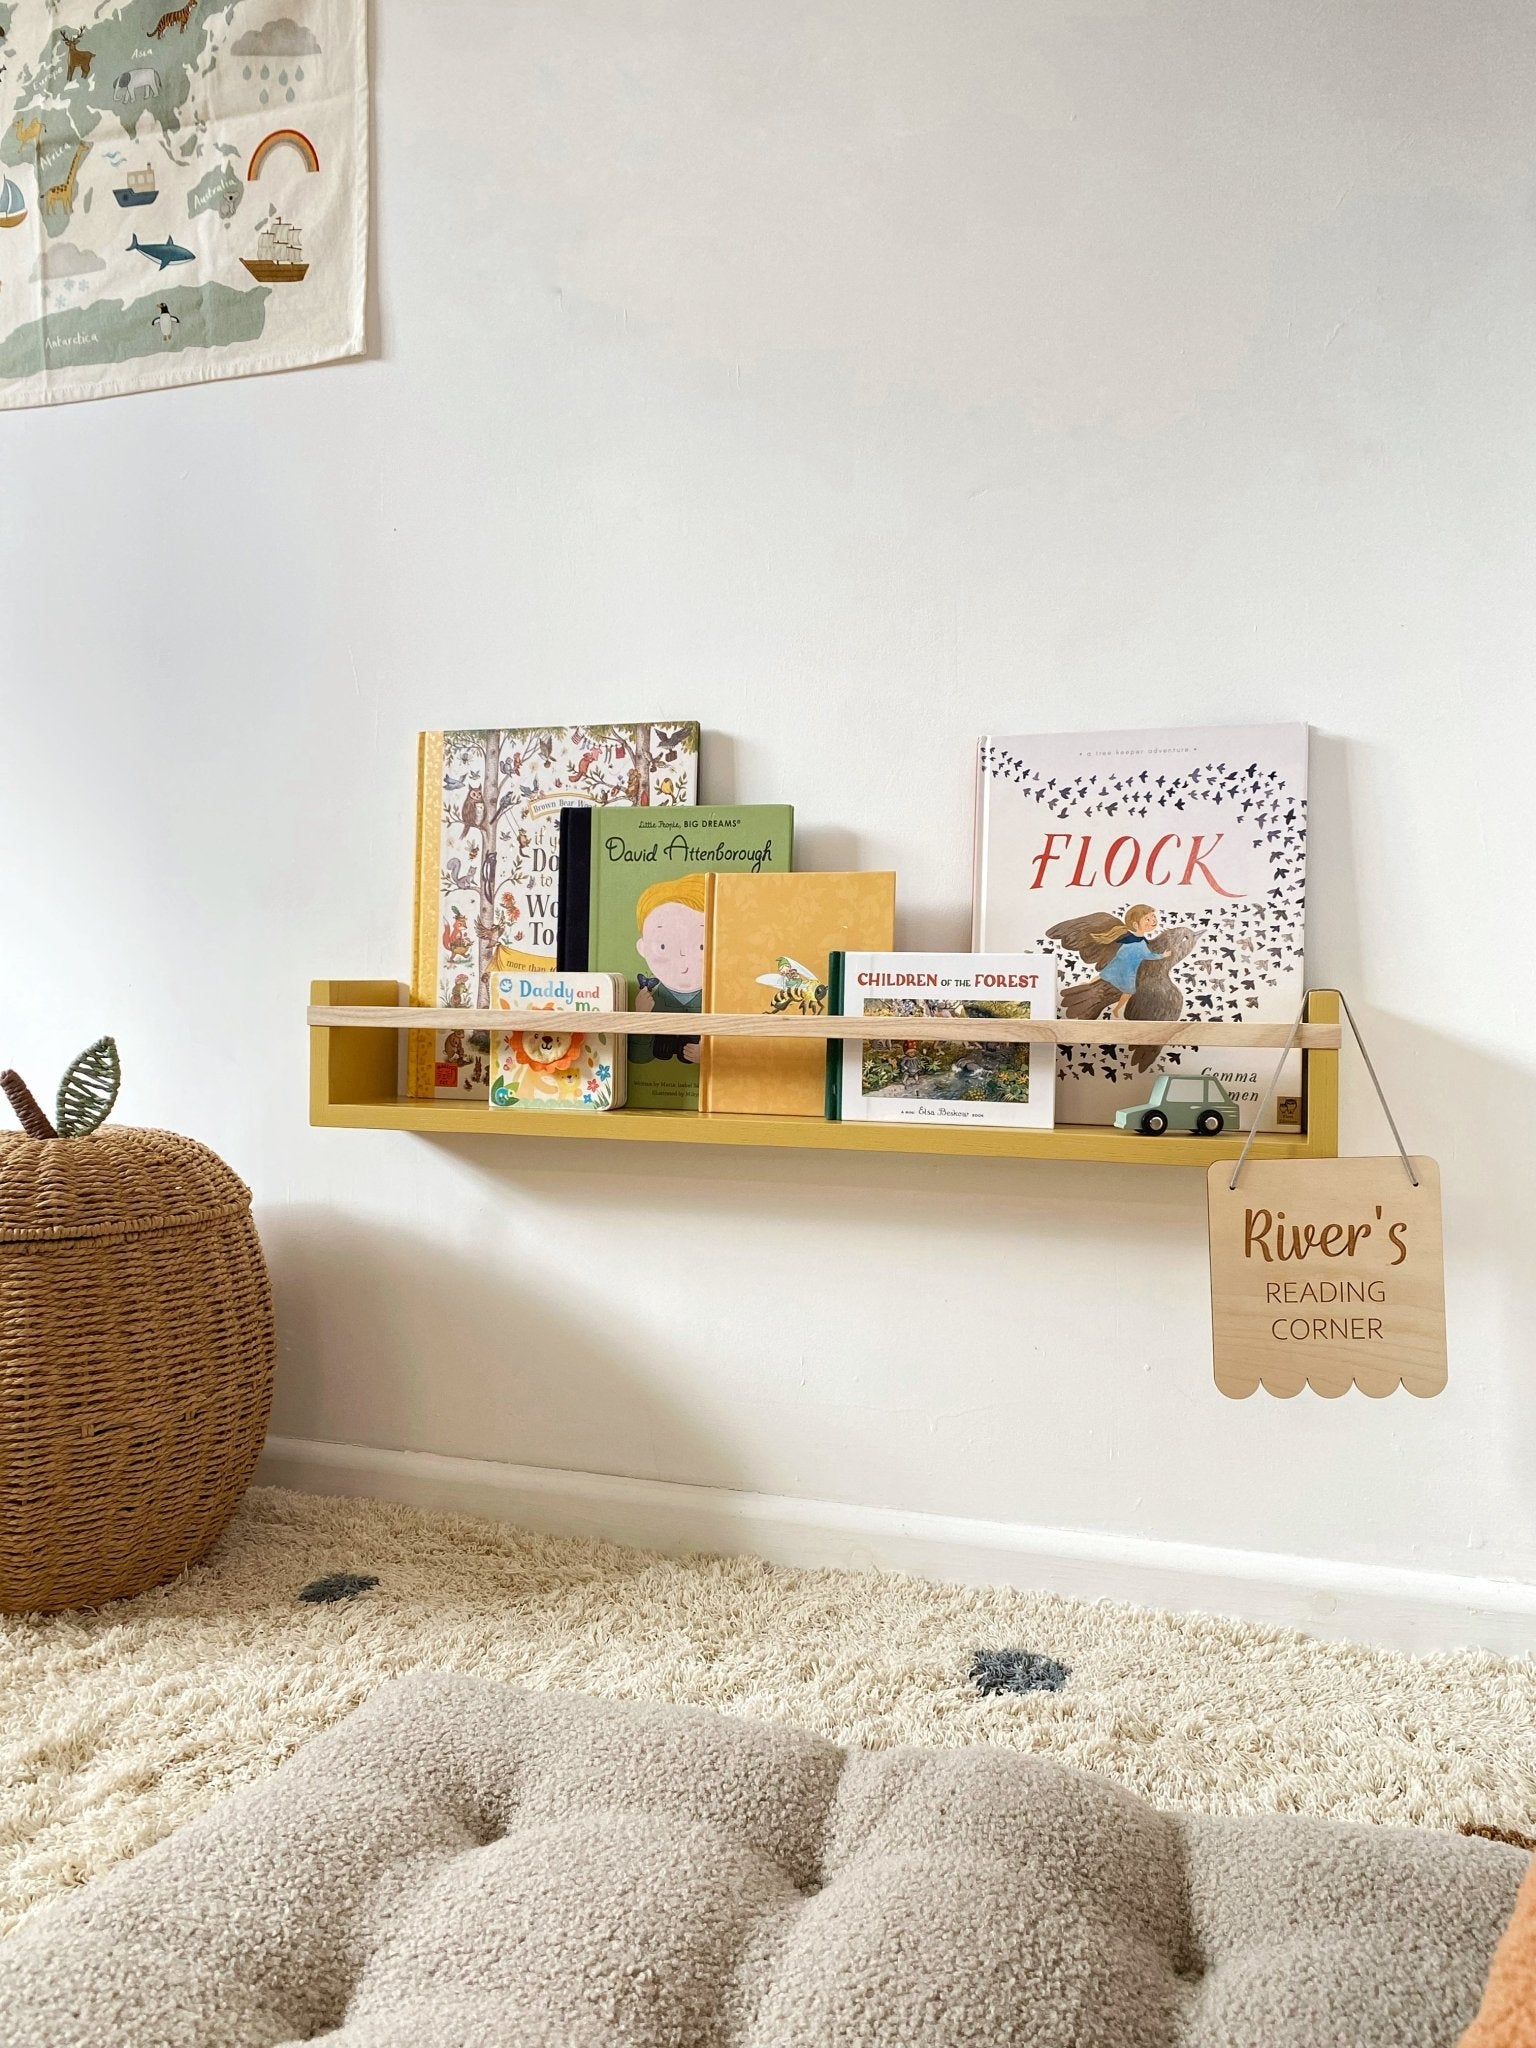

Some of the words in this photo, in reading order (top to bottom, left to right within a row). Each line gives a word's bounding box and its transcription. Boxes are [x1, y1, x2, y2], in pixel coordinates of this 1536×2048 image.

[131, 48, 153, 59] Asia
[33, 66, 64, 91] Europe
[40, 142, 72, 171] Africa
[194, 178, 237, 211] Australia
[45, 331, 99, 350] Antarctica
[1148, 746, 1189, 755] adventure
[533, 801, 556, 813] Brown
[559, 799, 575, 807] Bear
[638, 820, 657, 829] Little
[683, 820, 698, 828] BIG
[535, 825, 547, 846] if
[605, 836, 659, 862] David
[663, 834, 773, 874] Attenborough
[1029, 833, 1247, 898] FLOCK
[540, 873, 553, 888] to
[506, 960, 527, 971] more
[857, 972, 938, 987] CHILDREN
[940, 979, 953, 987] OF
[955, 979, 971, 988] THE
[974, 974, 1040, 989] FOREST
[519, 980, 574, 1005] Daddy
[576, 986, 601, 999] and
[918, 1106, 935, 1116] Elsa
[937, 1107, 970, 1118] Beskow
[1245, 1205, 1408, 1266] River's
[1266, 1280, 1386, 1304] READING
[1271, 1318, 1384, 1340] CORNER
